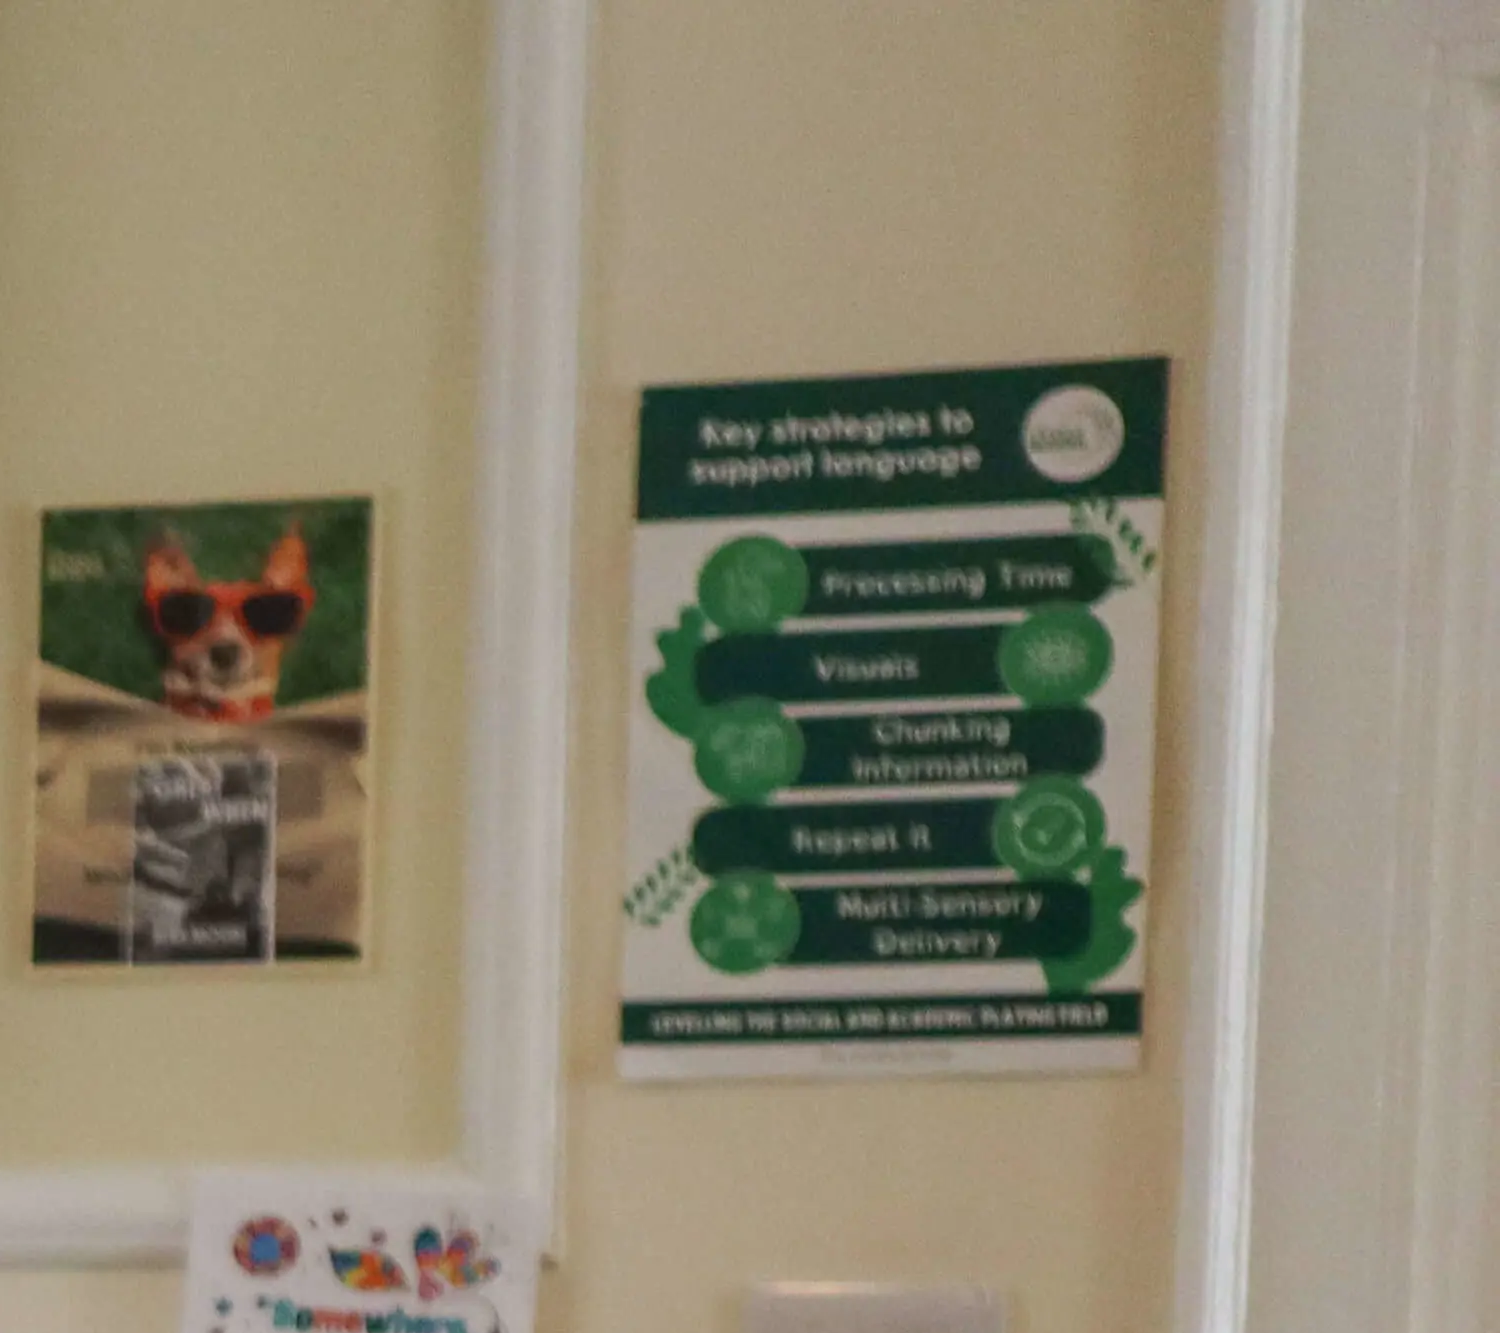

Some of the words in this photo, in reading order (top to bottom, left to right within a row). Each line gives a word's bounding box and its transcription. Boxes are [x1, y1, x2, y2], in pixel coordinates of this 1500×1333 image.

[701, 417, 762, 451] Key
[770, 407, 932, 446] strategies
[937, 402, 975, 436] to
[689, 449, 814, 488] support
[819, 444, 983, 482] language
[822, 566, 987, 600] Processing
[999, 559, 1074, 591] Time
[815, 654, 921, 683] Visuals
[872, 714, 1012, 747] Chunking
[851, 751, 1029, 782] Information
[872, 926, 1001, 958] Delivery
